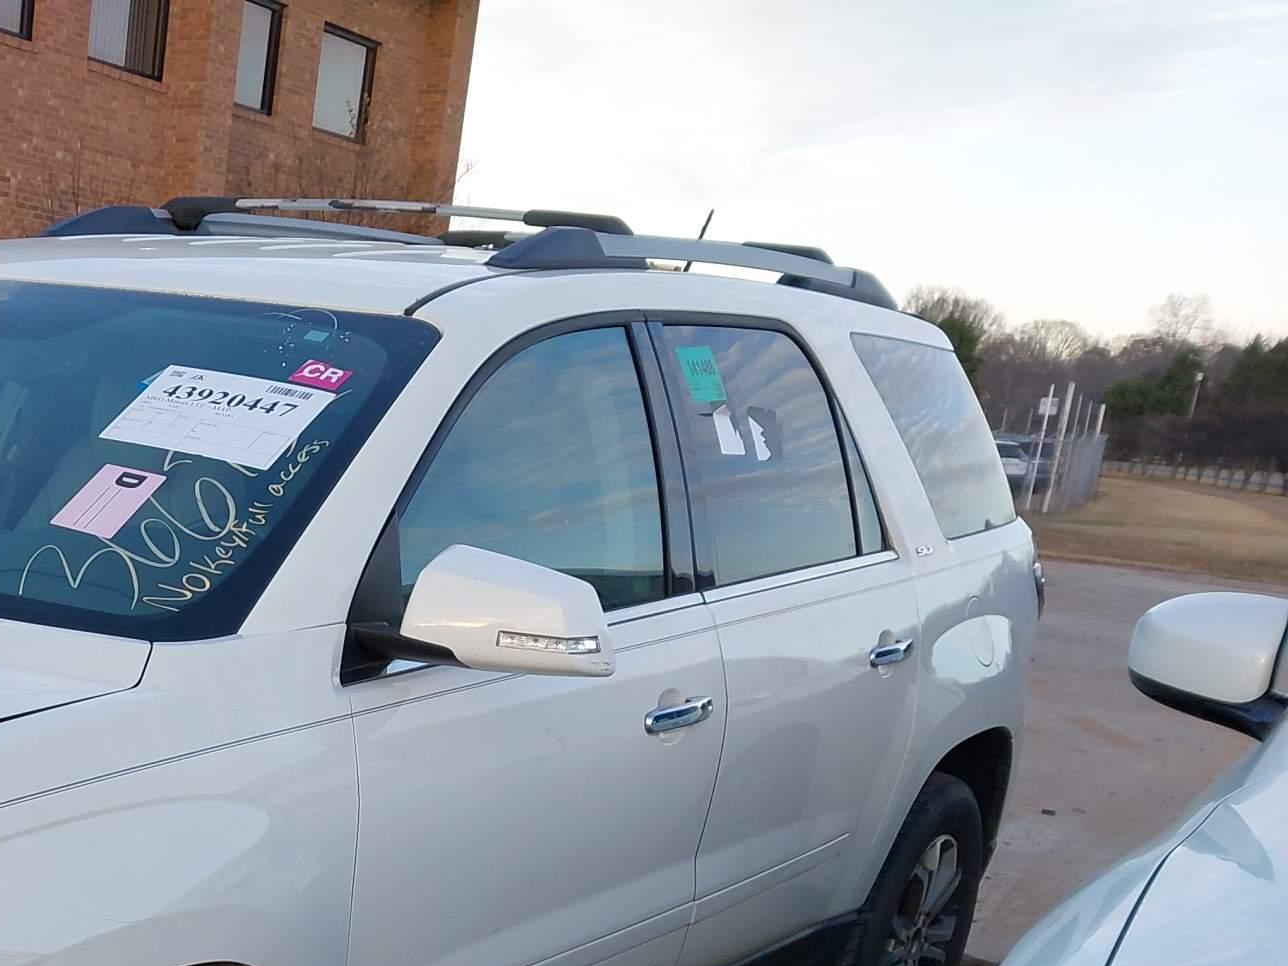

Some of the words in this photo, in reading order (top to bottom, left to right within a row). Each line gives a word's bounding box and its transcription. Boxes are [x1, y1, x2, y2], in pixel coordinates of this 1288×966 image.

[302, 364, 344, 383] CR
[162, 384, 299, 417] 43920447
[268, 439, 330, 497] access
